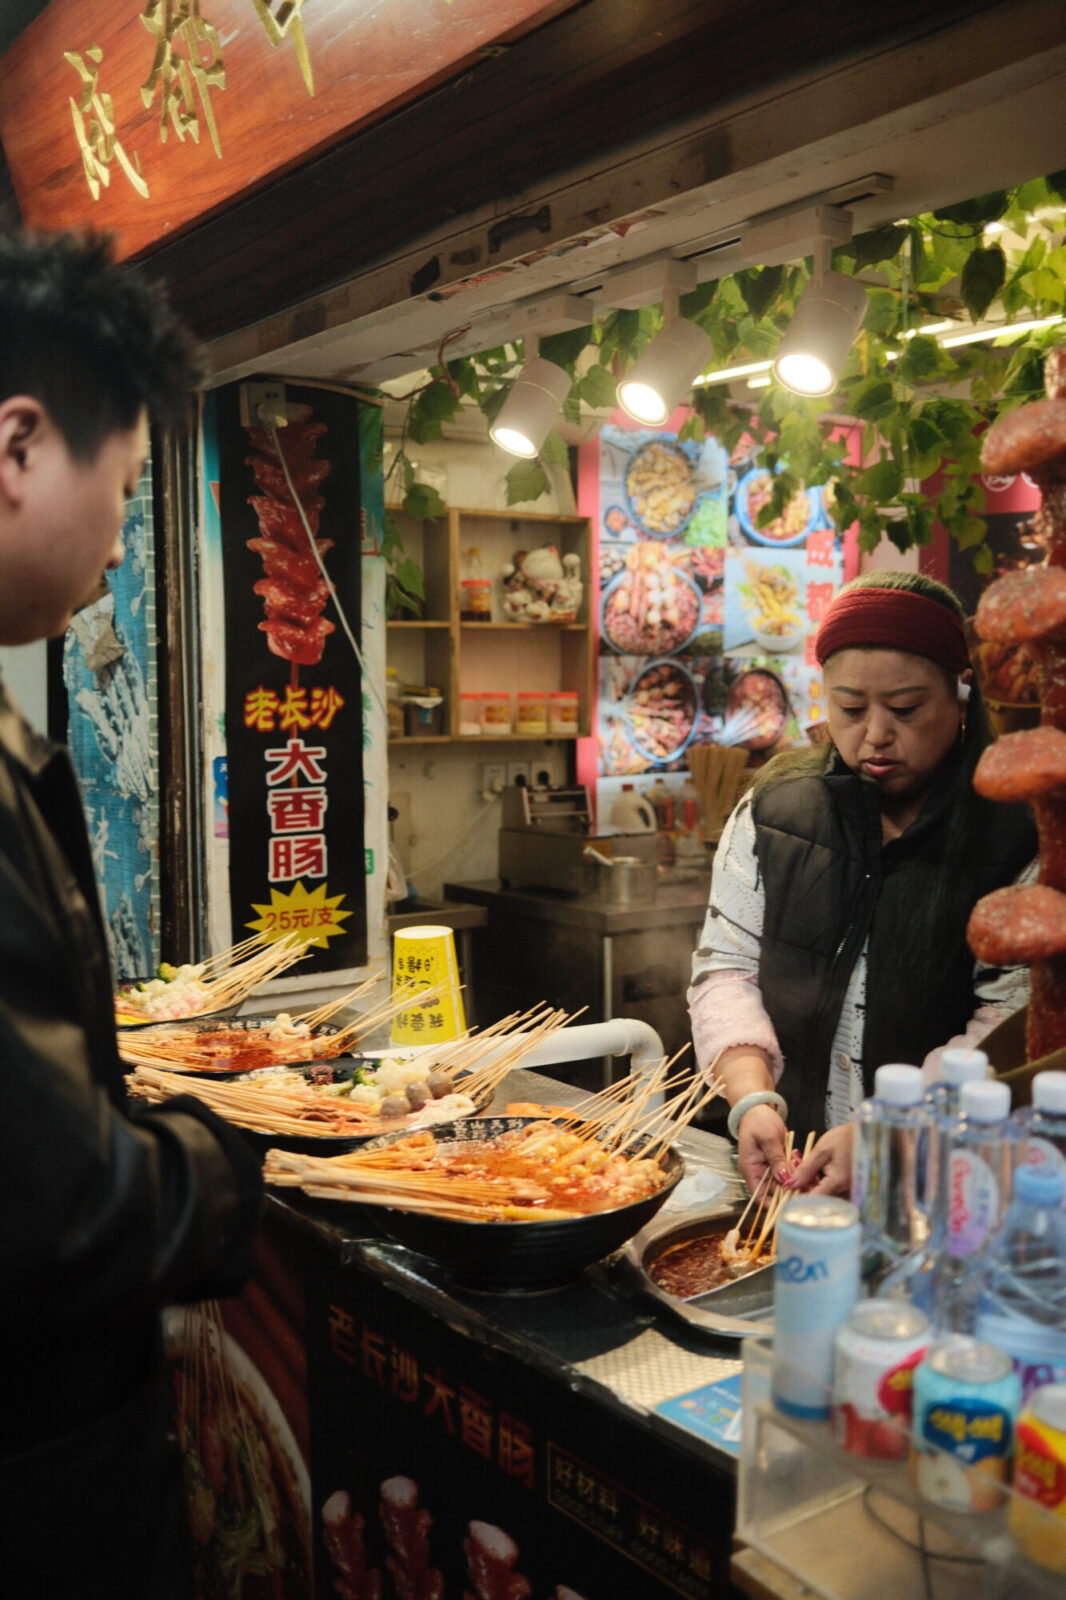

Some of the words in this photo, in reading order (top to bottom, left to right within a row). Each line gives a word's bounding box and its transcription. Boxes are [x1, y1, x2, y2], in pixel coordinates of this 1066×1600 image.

[244, 685, 344, 731] 老长沙
[264, 739, 328, 882] 大香肠
[265, 905, 335, 932] 25元/支
